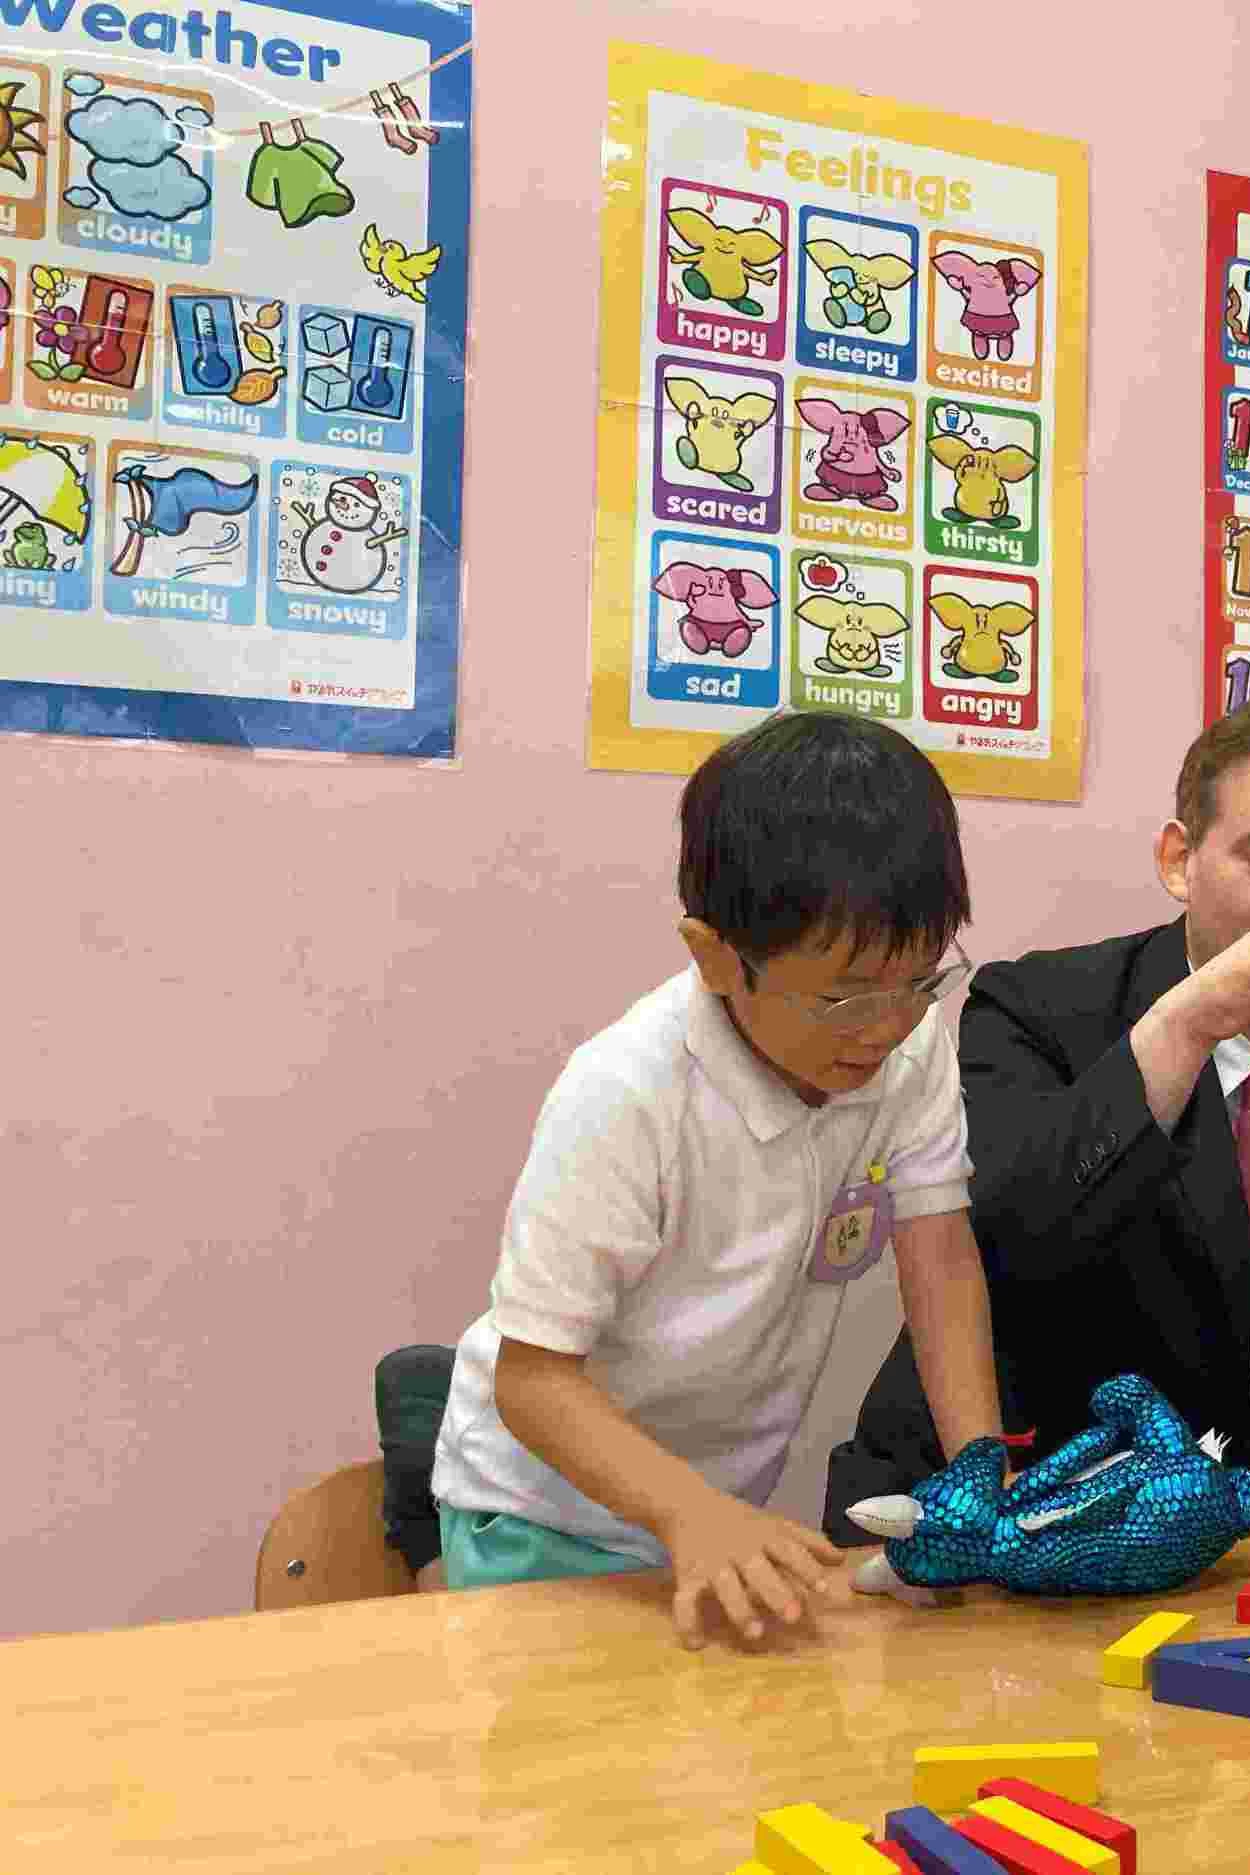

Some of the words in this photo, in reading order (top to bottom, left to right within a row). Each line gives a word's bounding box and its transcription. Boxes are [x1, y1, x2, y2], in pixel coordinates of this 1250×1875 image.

[0, 0, 341, 81] Weather
[744, 126, 974, 220] Feelings
[77, 217, 193, 259] cloudy
[677, 313, 767, 356] happy
[815, 337, 899, 376] sleepy
[936, 364, 1033, 395] excited
[48, 387, 130, 412] warm
[192, 402, 261, 433] hilly
[327, 423, 384, 446] cold
[666, 494, 767, 526] scared
[798, 512, 907, 543] nervous
[941, 528, 1024, 561] thirsty
[132, 583, 228, 623] windy
[288, 599, 387, 633] snowy
[685, 673, 741, 698] sad
[805, 678, 902, 714] hungry
[941, 693, 1021, 723] angry
